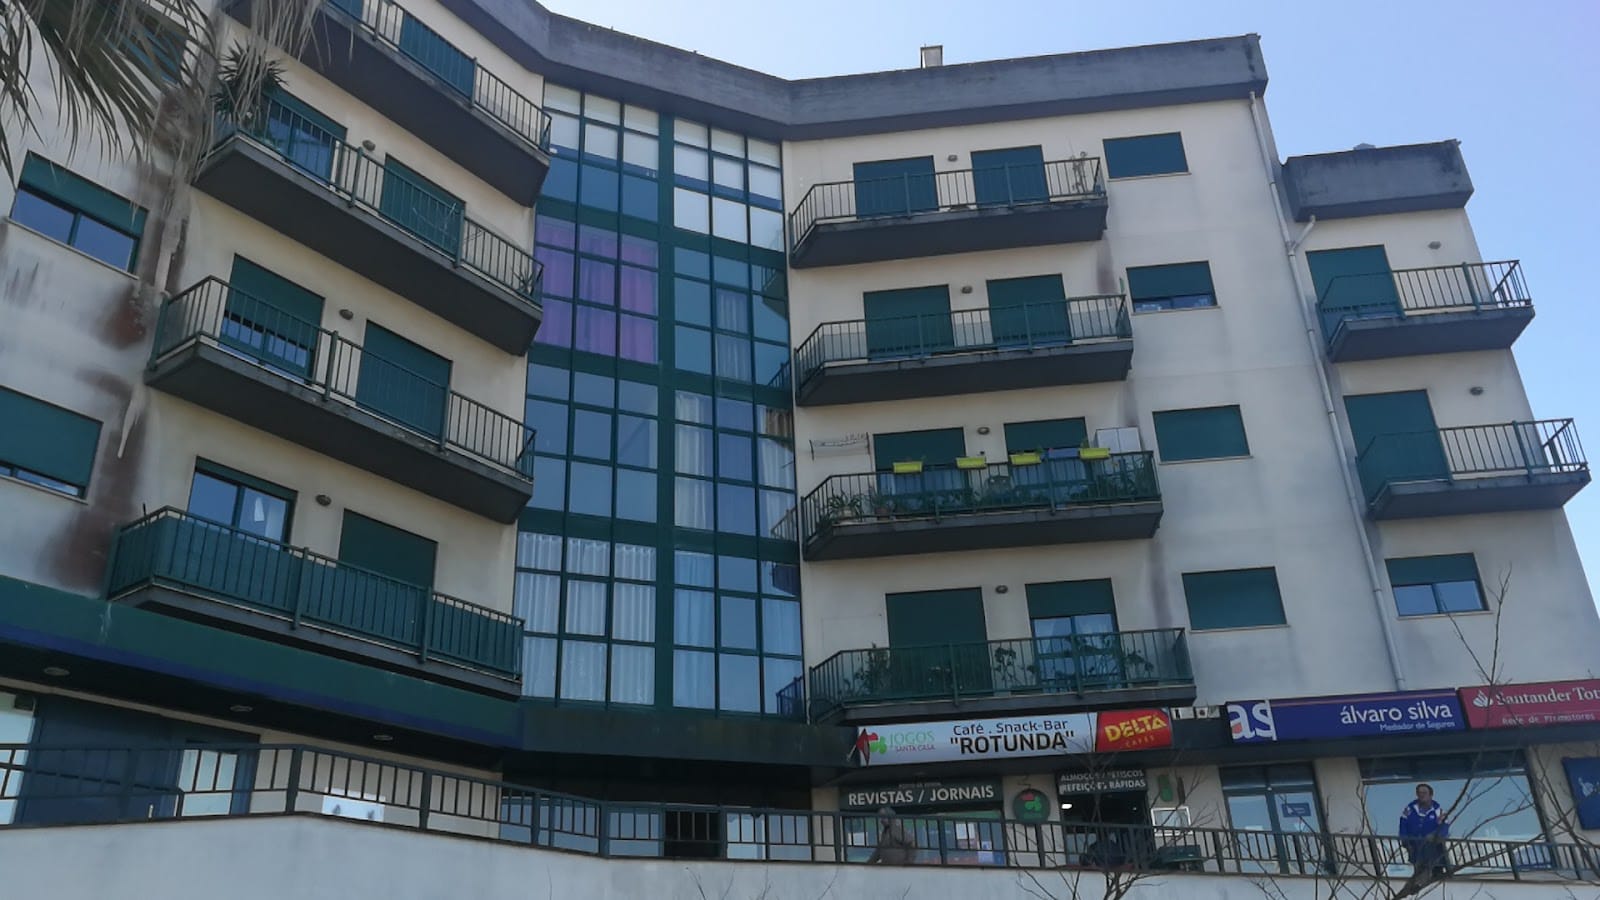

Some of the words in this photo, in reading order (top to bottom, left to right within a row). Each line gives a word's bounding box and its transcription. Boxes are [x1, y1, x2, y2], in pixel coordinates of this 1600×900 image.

[1496, 687, 1571, 705] Santander
[1340, 705, 1402, 723] álvaro
[1407, 700, 1452, 720] silva
[953, 723, 984, 736] Café
[996, 720, 1068, 734] Snack-Bar
[1104, 716, 1167, 742] DELTA
[889, 731, 935, 748] JOGOS
[950, 731, 1074, 754] "ROTUNDA"
[848, 790, 914, 806] REVISTAS
[930, 785, 994, 802] JORNAIS
